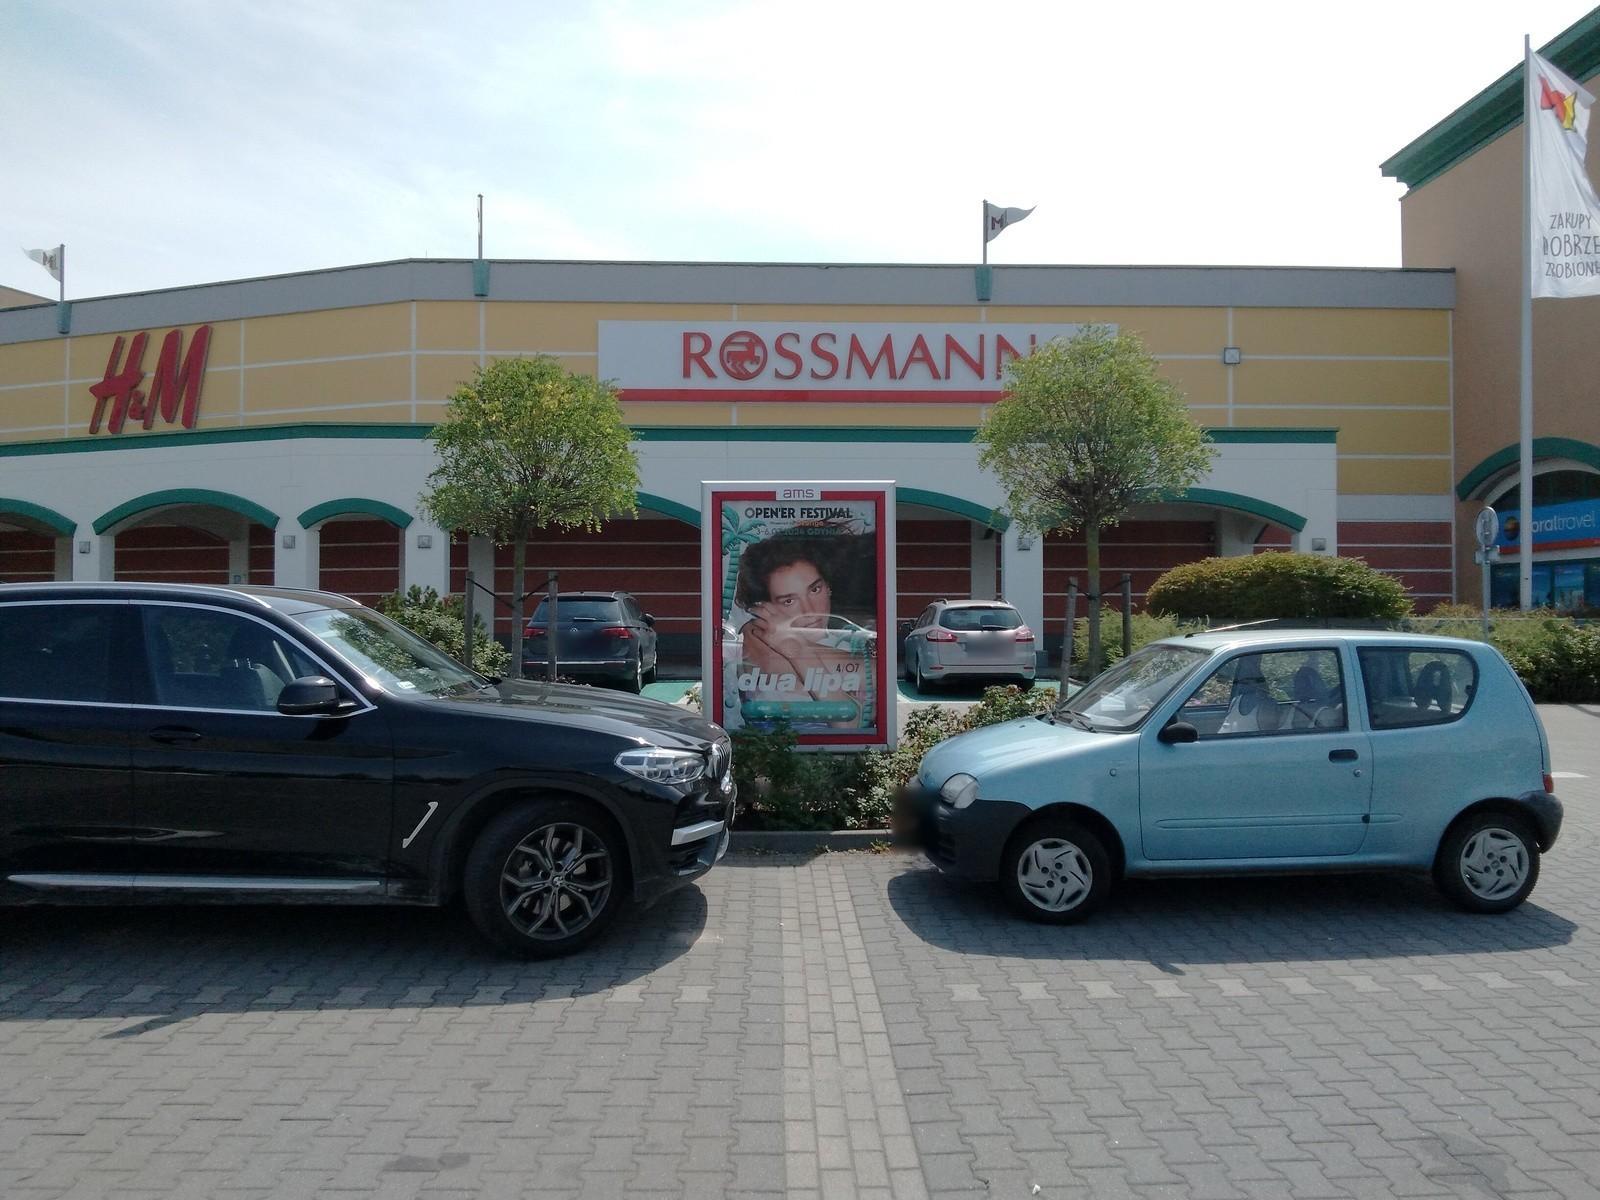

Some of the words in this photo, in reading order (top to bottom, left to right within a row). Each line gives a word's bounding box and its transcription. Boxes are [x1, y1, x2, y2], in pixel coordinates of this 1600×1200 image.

[1550, 211, 1592, 229] ZAKUPY
[88, 324, 213, 435] H&M
[783, 488, 814, 499] ams
[744, 507, 796, 519] OPEN'ER
[800, 507, 853, 519] FESTIVAL
[738, 667, 797, 691] dua
[803, 667, 861, 697] lipa
